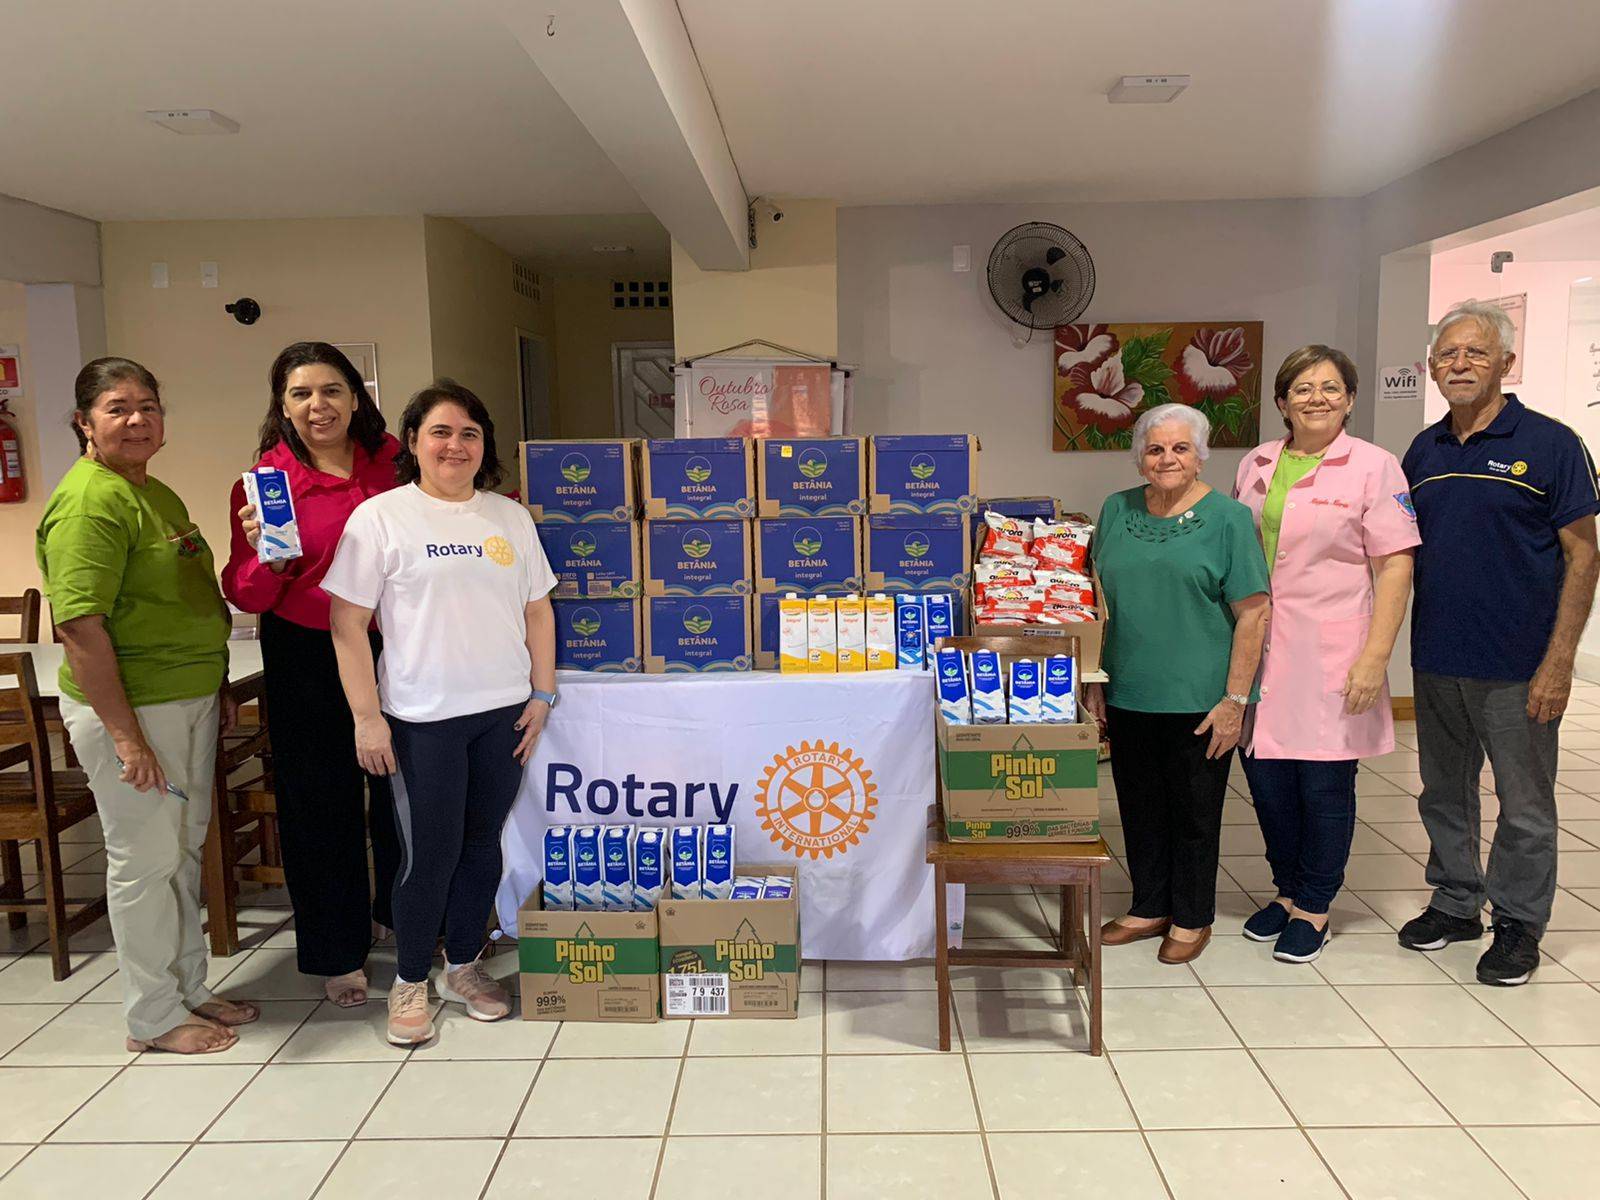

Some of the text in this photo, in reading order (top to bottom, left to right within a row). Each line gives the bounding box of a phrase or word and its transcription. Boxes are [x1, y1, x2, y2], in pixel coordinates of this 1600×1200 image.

[699, 375, 773, 397] Outubro
[1385, 375, 1416, 388] Wifi
[708, 393, 750, 415] Rosa
[1487, 459, 1511, 471] Rotary
[555, 483, 597, 495] BETÂNIA
[681, 483, 717, 493] BETÂNIA
[792, 479, 833, 490] BETÂNIA
[905, 480, 940, 490] BETÂNIA
[686, 494, 712, 502] integral
[799, 494, 827, 502] integral
[910, 490, 935, 498] integral
[562, 498, 592, 508] integral
[426, 540, 483, 558] Rotary
[565, 557, 602, 568] BETÂNIA
[677, 560, 717, 570] BETÂNIA
[788, 557, 828, 568] BETÂNIA
[899, 558, 934, 568] BETÂNIA
[684, 573, 712, 582] integral
[795, 571, 823, 580] integral
[566, 637, 607, 648] BETÂNIA
[678, 636, 718, 647] BETÂNIA
[572, 650, 601, 660] integral
[684, 649, 712, 658] integral
[793, 752, 845, 767] ROTARY
[990, 752, 1056, 777] Pinho
[1005, 775, 1043, 800] Sol
[545, 763, 740, 825] Rotary
[965, 821, 992, 830] Pinho
[774, 817, 859, 848] INTERNATIONAL
[971, 829, 987, 839] Sol
[555, 940, 615, 962] Pinho
[715, 939, 775, 962] Pinho
[569, 961, 605, 984] Sol
[729, 960, 764, 982] Sol
[692, 987, 725, 996] 7 9 437
